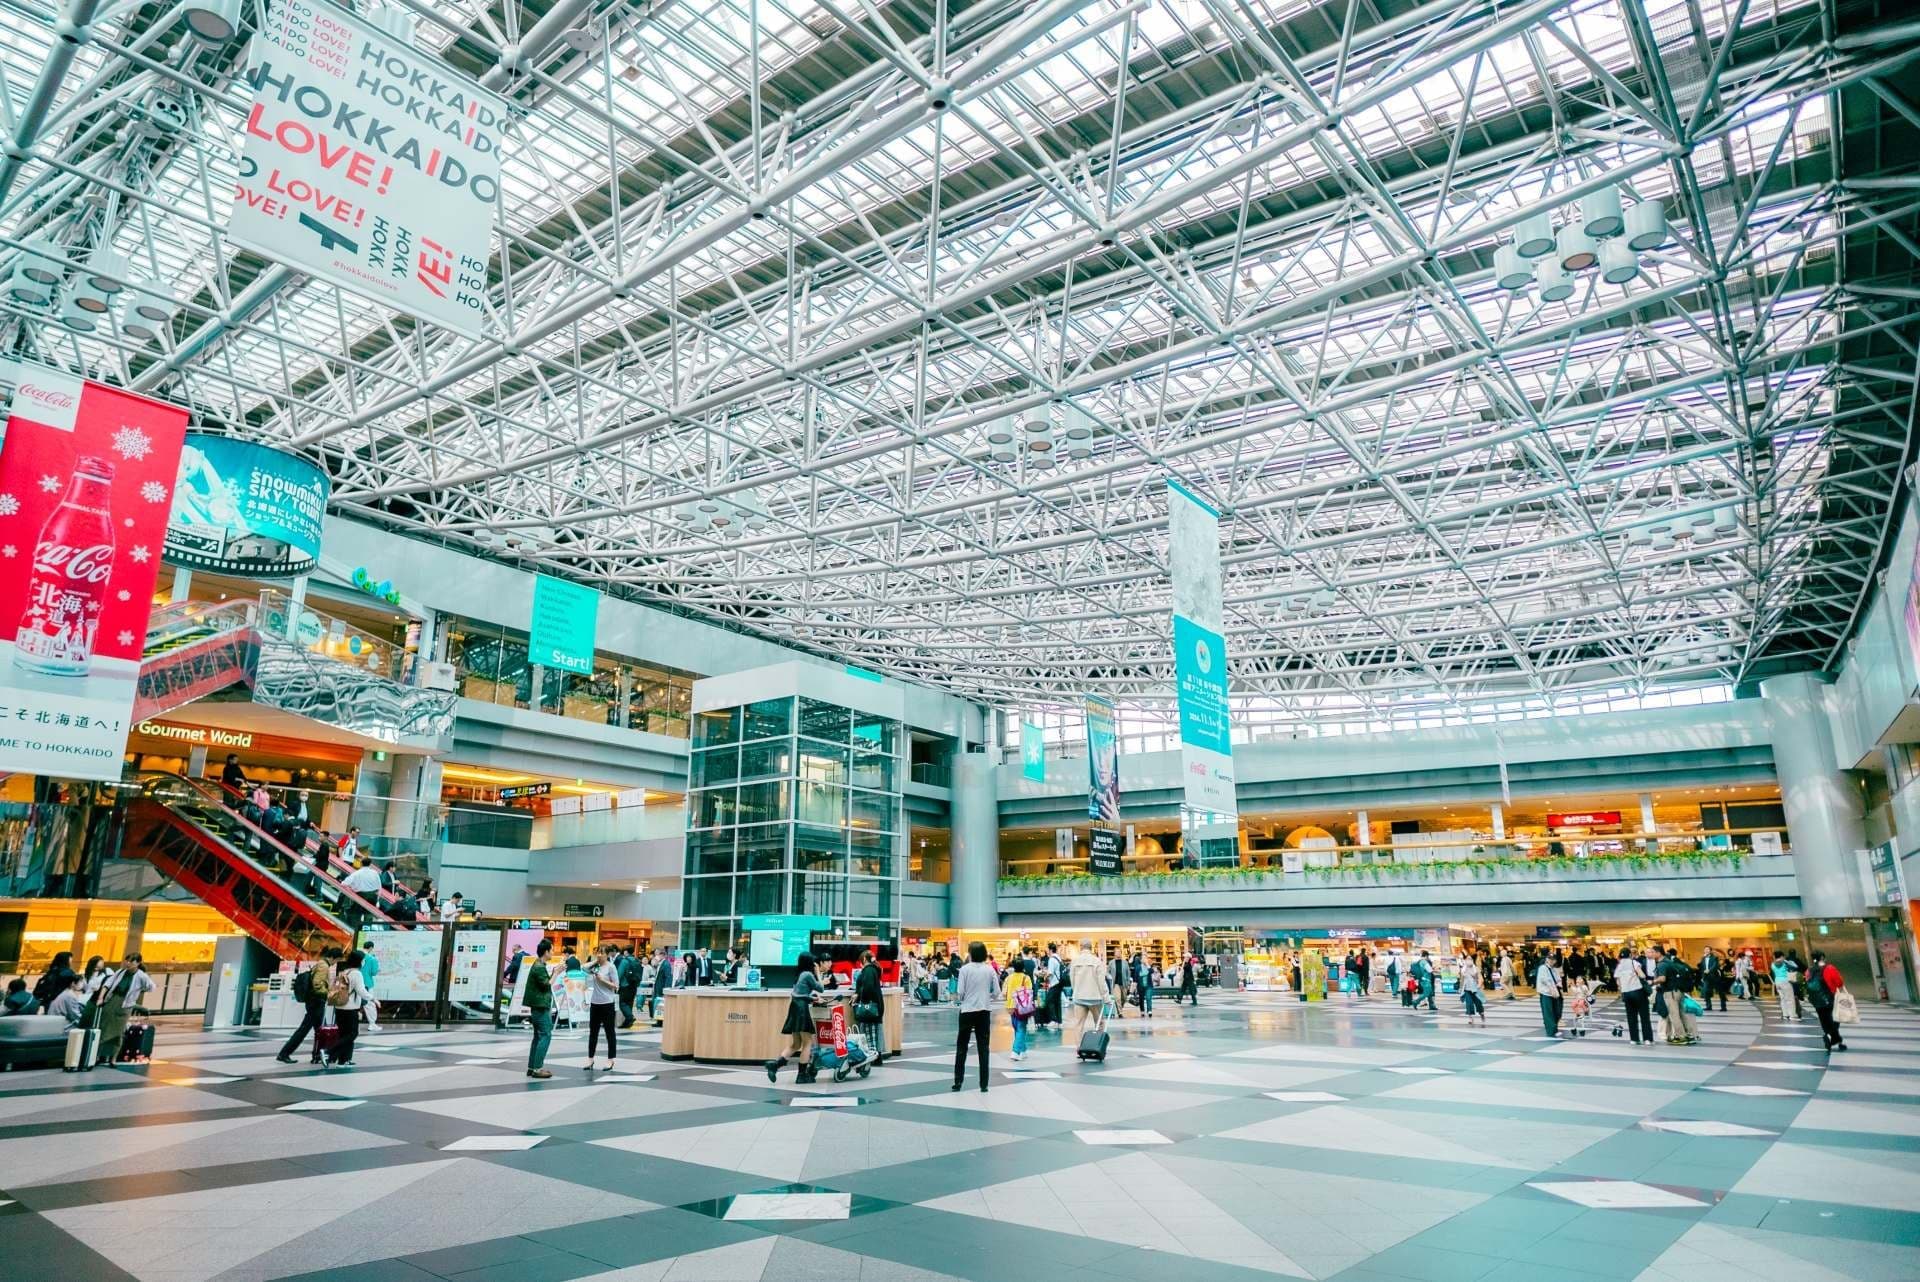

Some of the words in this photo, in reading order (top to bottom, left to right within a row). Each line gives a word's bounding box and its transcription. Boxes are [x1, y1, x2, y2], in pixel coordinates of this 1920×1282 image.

[313, 28, 350, 53] LOVE!
[315, 15, 352, 41] LOVE!
[309, 54, 346, 80] LOVE!
[310, 41, 348, 67] LOVE!
[254, 61, 498, 203] HOKKAIDO
[247, 102, 394, 195] LOVE!
[267, 169, 365, 228] LOVE!
[139, 721, 207, 741] Gourmet
[210, 729, 252, 748] World
[24, 740, 42, 751] TO
[46, 743, 113, 758] HOKKAIDO
